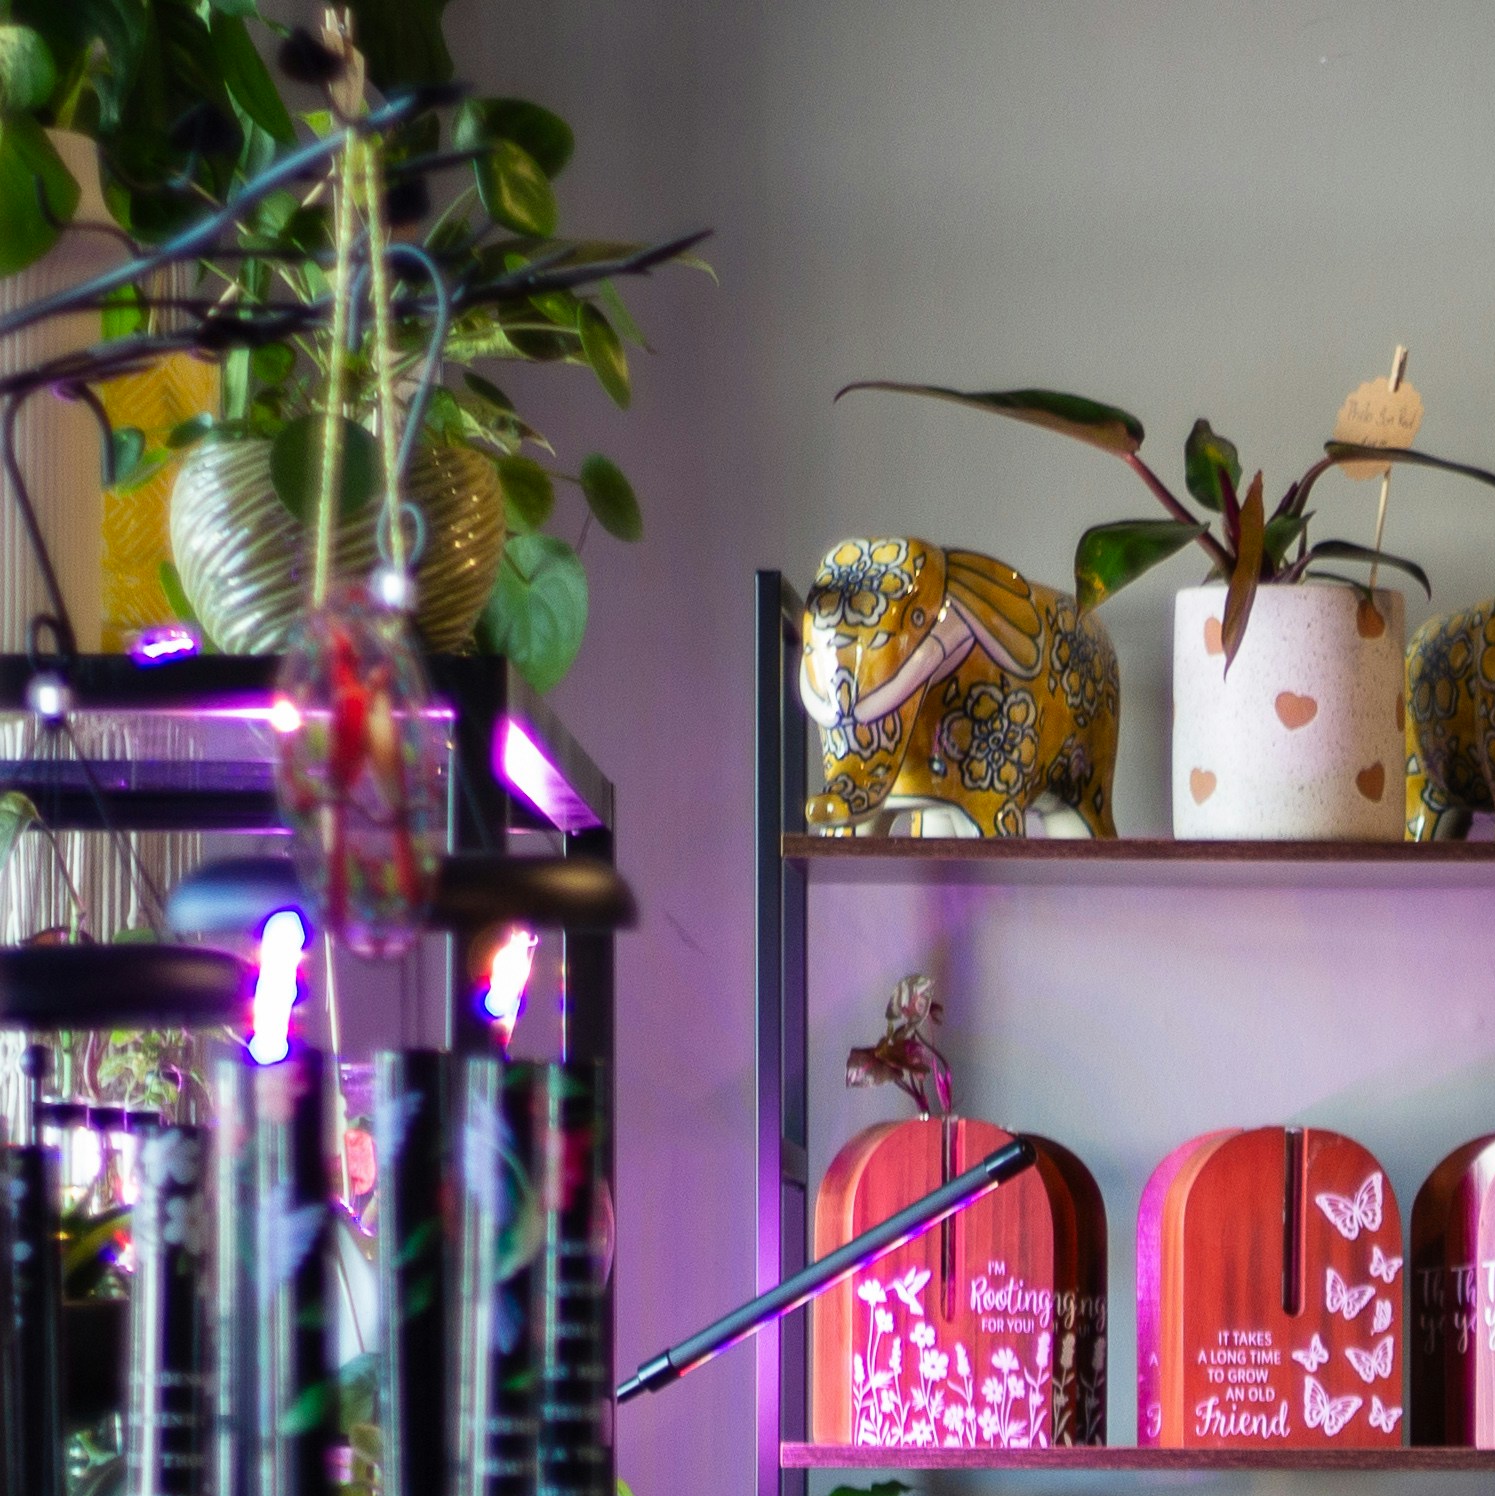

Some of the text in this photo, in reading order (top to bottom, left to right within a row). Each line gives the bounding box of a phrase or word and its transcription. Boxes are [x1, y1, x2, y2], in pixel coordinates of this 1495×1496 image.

[987, 1260, 1006, 1276] I'M
[970, 1275, 1053, 1329] Rooting
[981, 1317, 1035, 1334] FOR YOU!
[1217, 1331, 1272, 1346] IT TAKES
[1197, 1350, 1281, 1365] A LONG TIME
[1207, 1368, 1269, 1384] TO GROW
[1225, 1387, 1275, 1402] AN OLD
[1195, 1396, 1291, 1439] Friend
